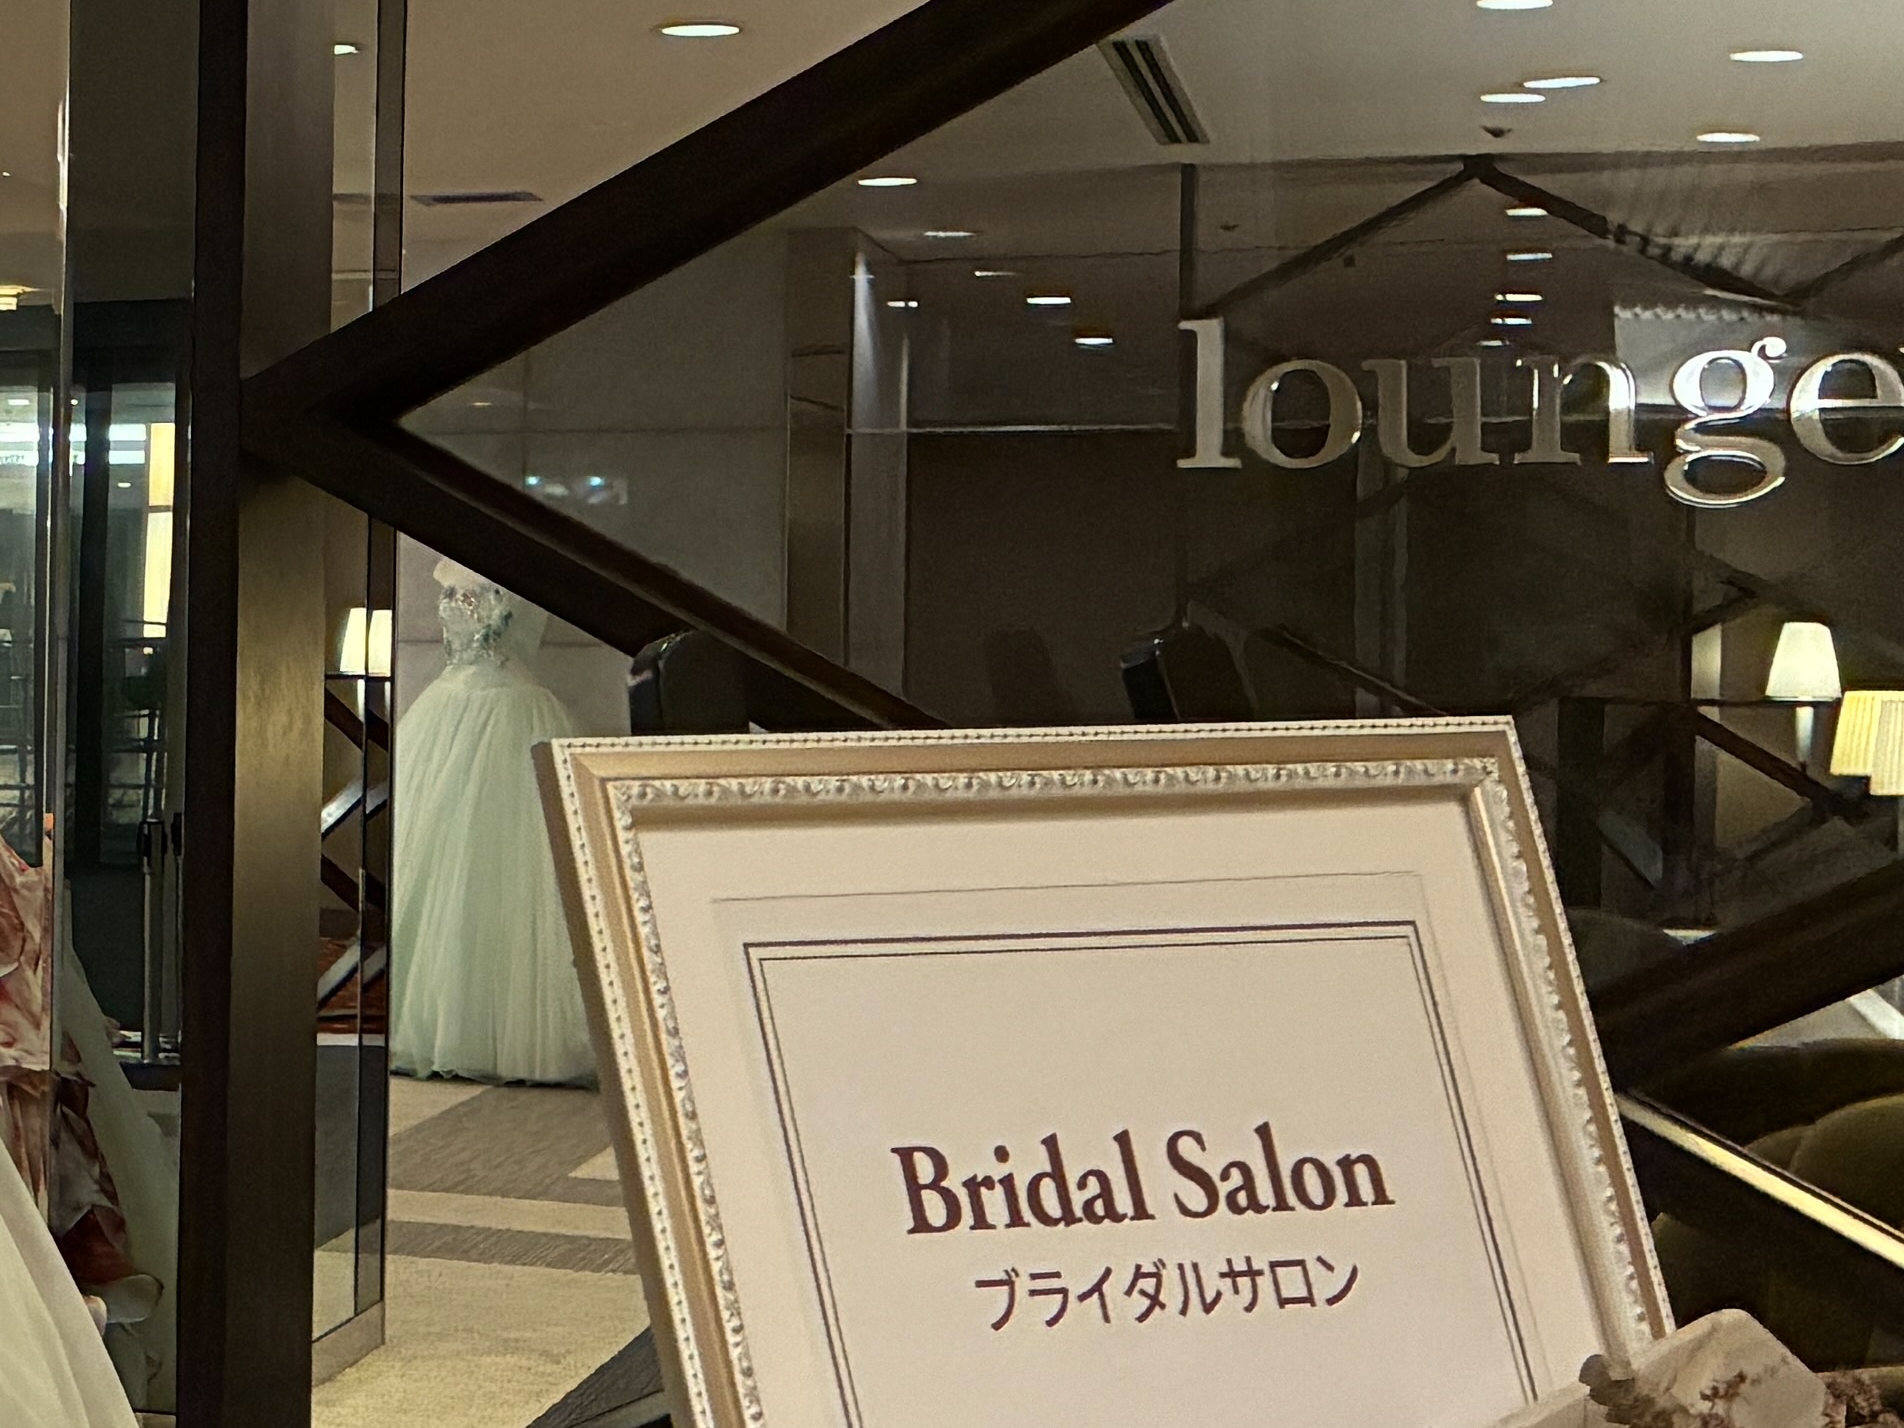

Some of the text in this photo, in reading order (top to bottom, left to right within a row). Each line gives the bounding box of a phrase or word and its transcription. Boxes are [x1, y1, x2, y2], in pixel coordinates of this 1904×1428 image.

[1177, 317, 1904, 509] lounge
[890, 1121, 1396, 1235] Bridal Salon
[975, 1256, 1359, 1331] ブライダルサロン
